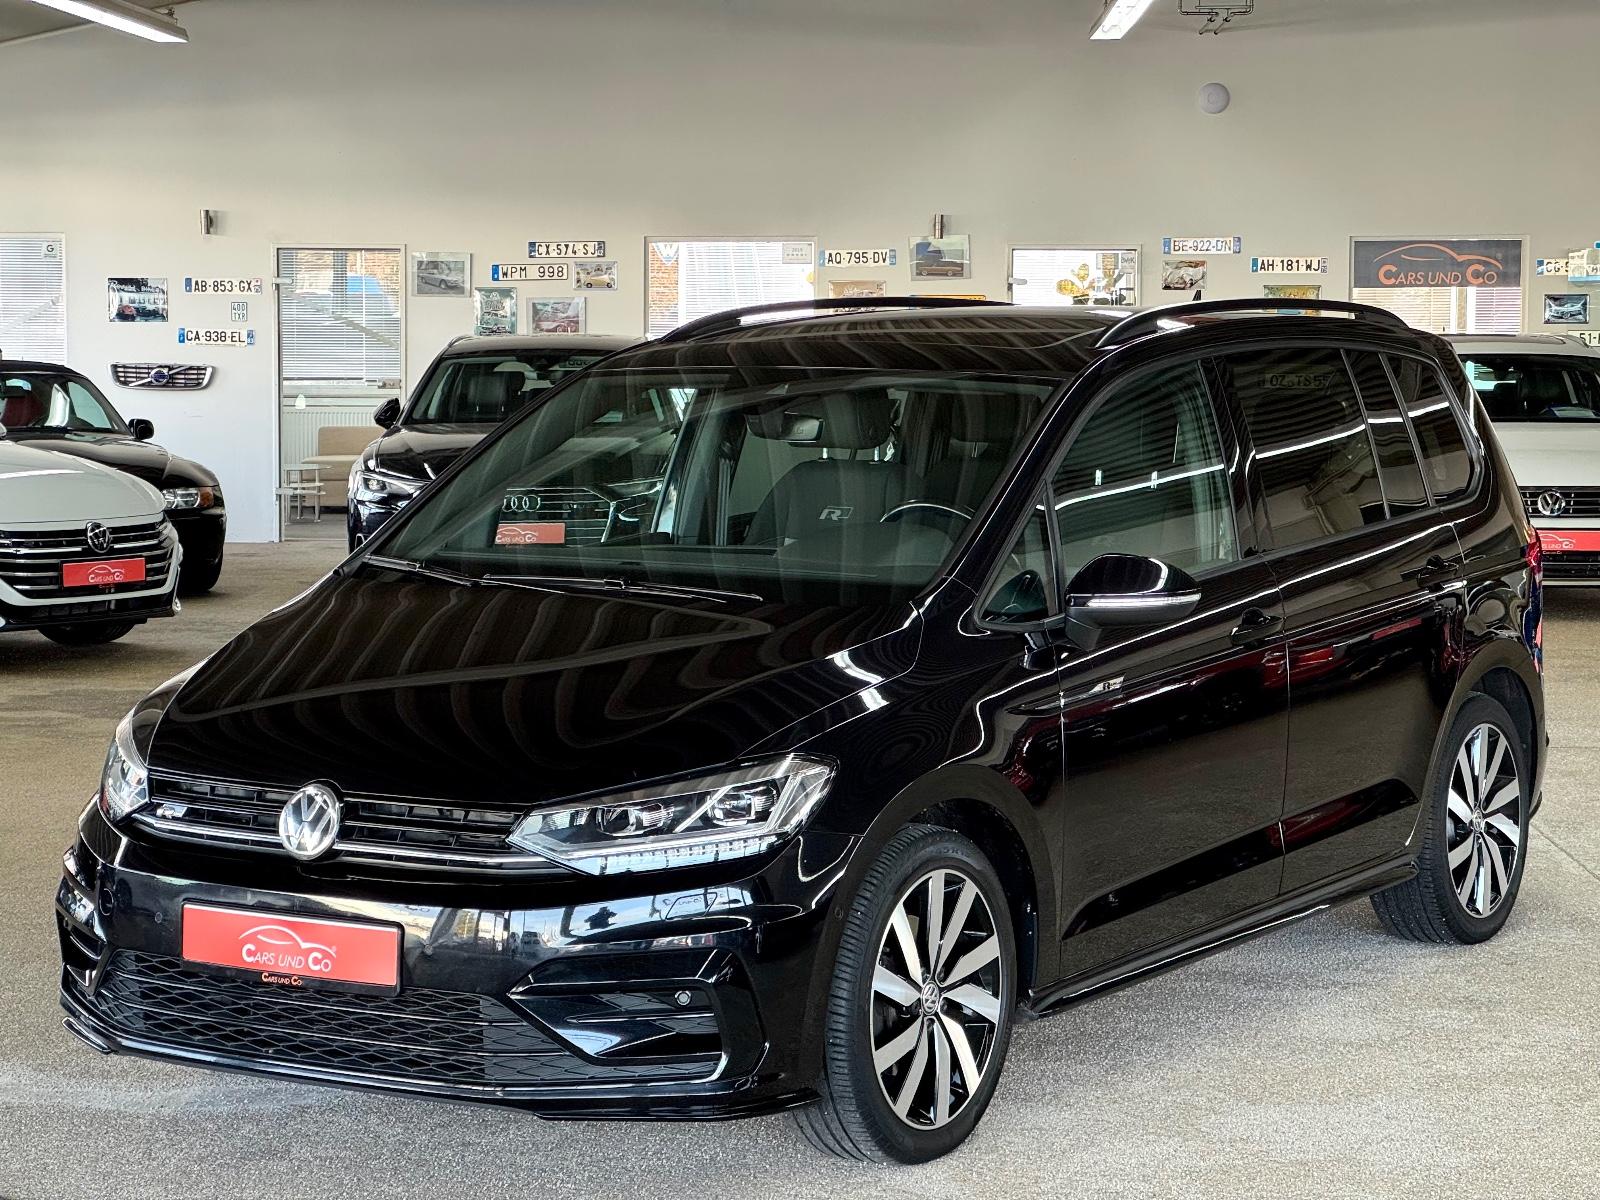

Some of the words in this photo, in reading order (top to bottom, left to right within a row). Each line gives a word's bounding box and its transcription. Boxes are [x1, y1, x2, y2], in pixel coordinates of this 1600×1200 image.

[537, 243, 596, 256] CX-574-SJ
[827, 251, 887, 264] AQ-795-DV
[501, 266, 527, 279] WPM
[537, 265, 564, 278] 998
[1259, 259, 1320, 272] AH-181-WJ
[1378, 264, 1424, 285] CARS
[1428, 272, 1461, 285] UND
[1466, 263, 1498, 285] CO
[194, 280, 252, 293] AB-853-GX
[186, 330, 246, 343] CA-938-EL
[1580, 333, 1600, 344] 51-
[241, 943, 274, 966] CARS
[278, 954, 304, 969] UND
[308, 951, 332, 973] CO
[261, 972, 278, 983] CARS
[291, 976, 303, 986] CO
